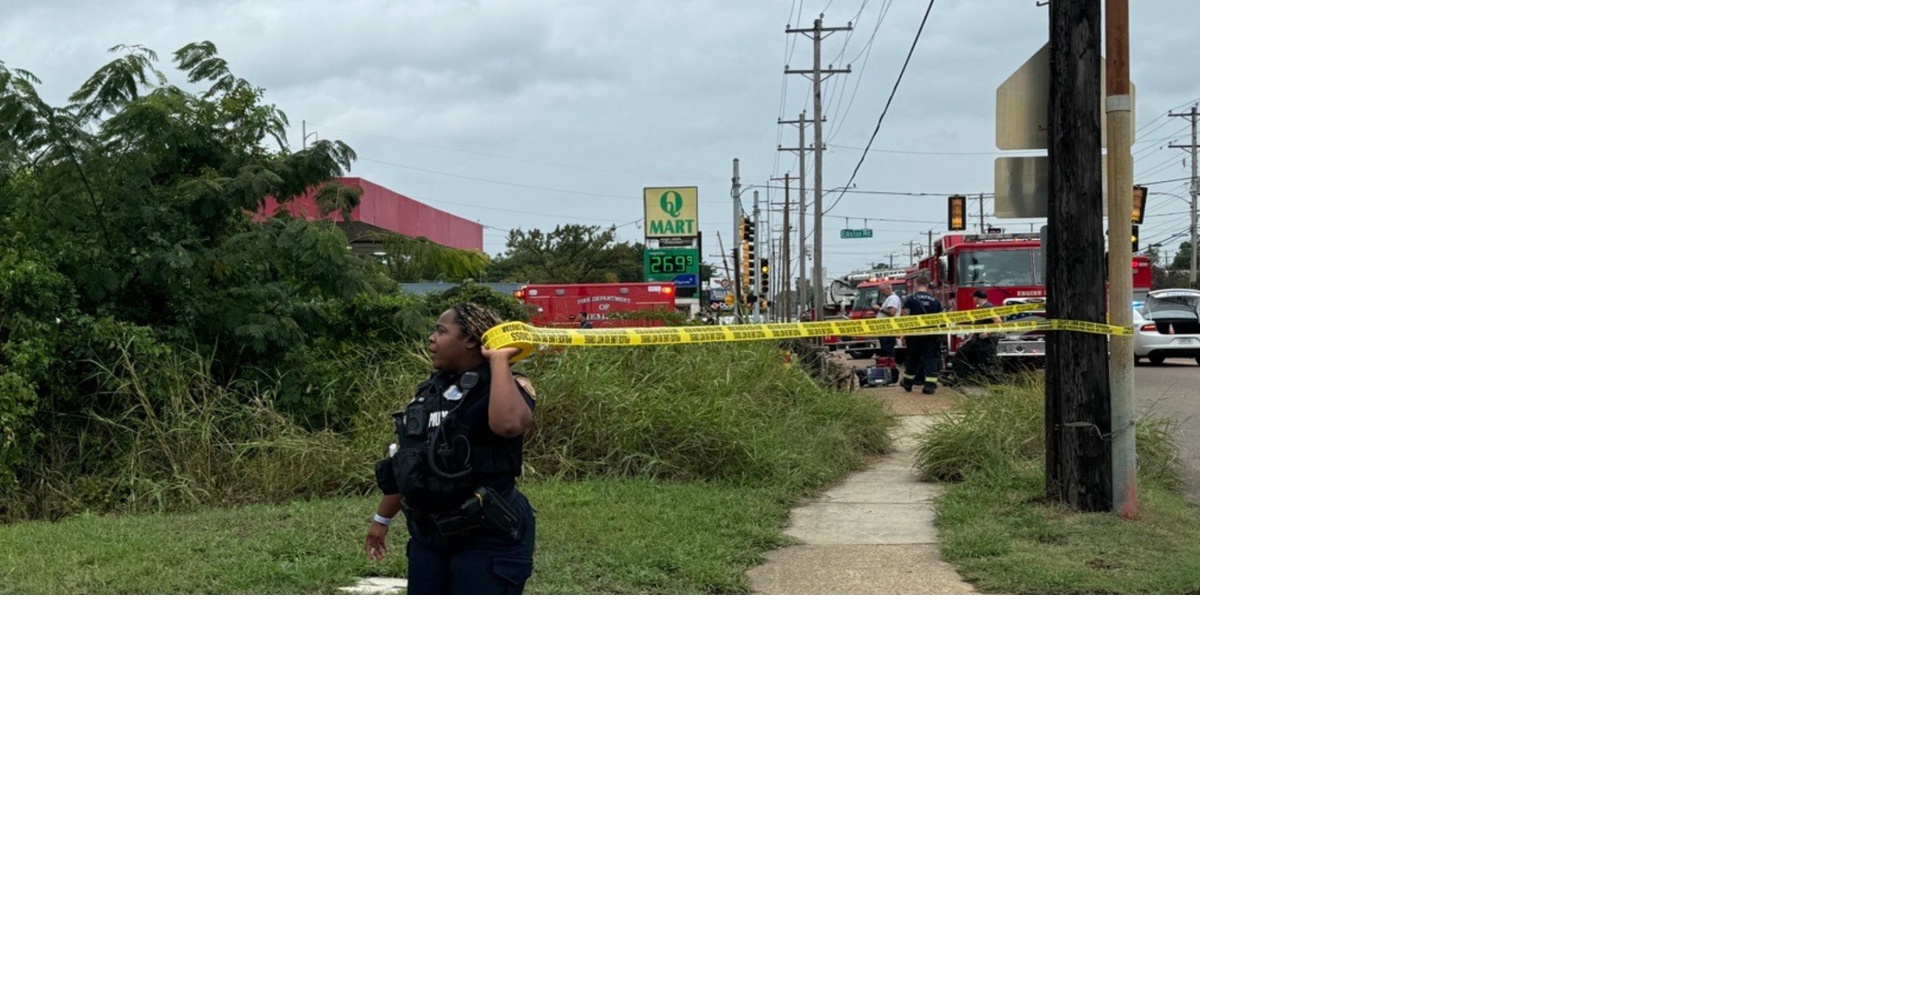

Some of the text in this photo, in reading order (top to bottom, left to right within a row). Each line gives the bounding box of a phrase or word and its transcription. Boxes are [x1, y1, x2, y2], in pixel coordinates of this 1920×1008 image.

[660, 190, 683, 217] Q
[650, 220, 694, 235] MART
[577, 295, 632, 305] FIRE DEPARTMENT
[598, 303, 611, 311] OF
